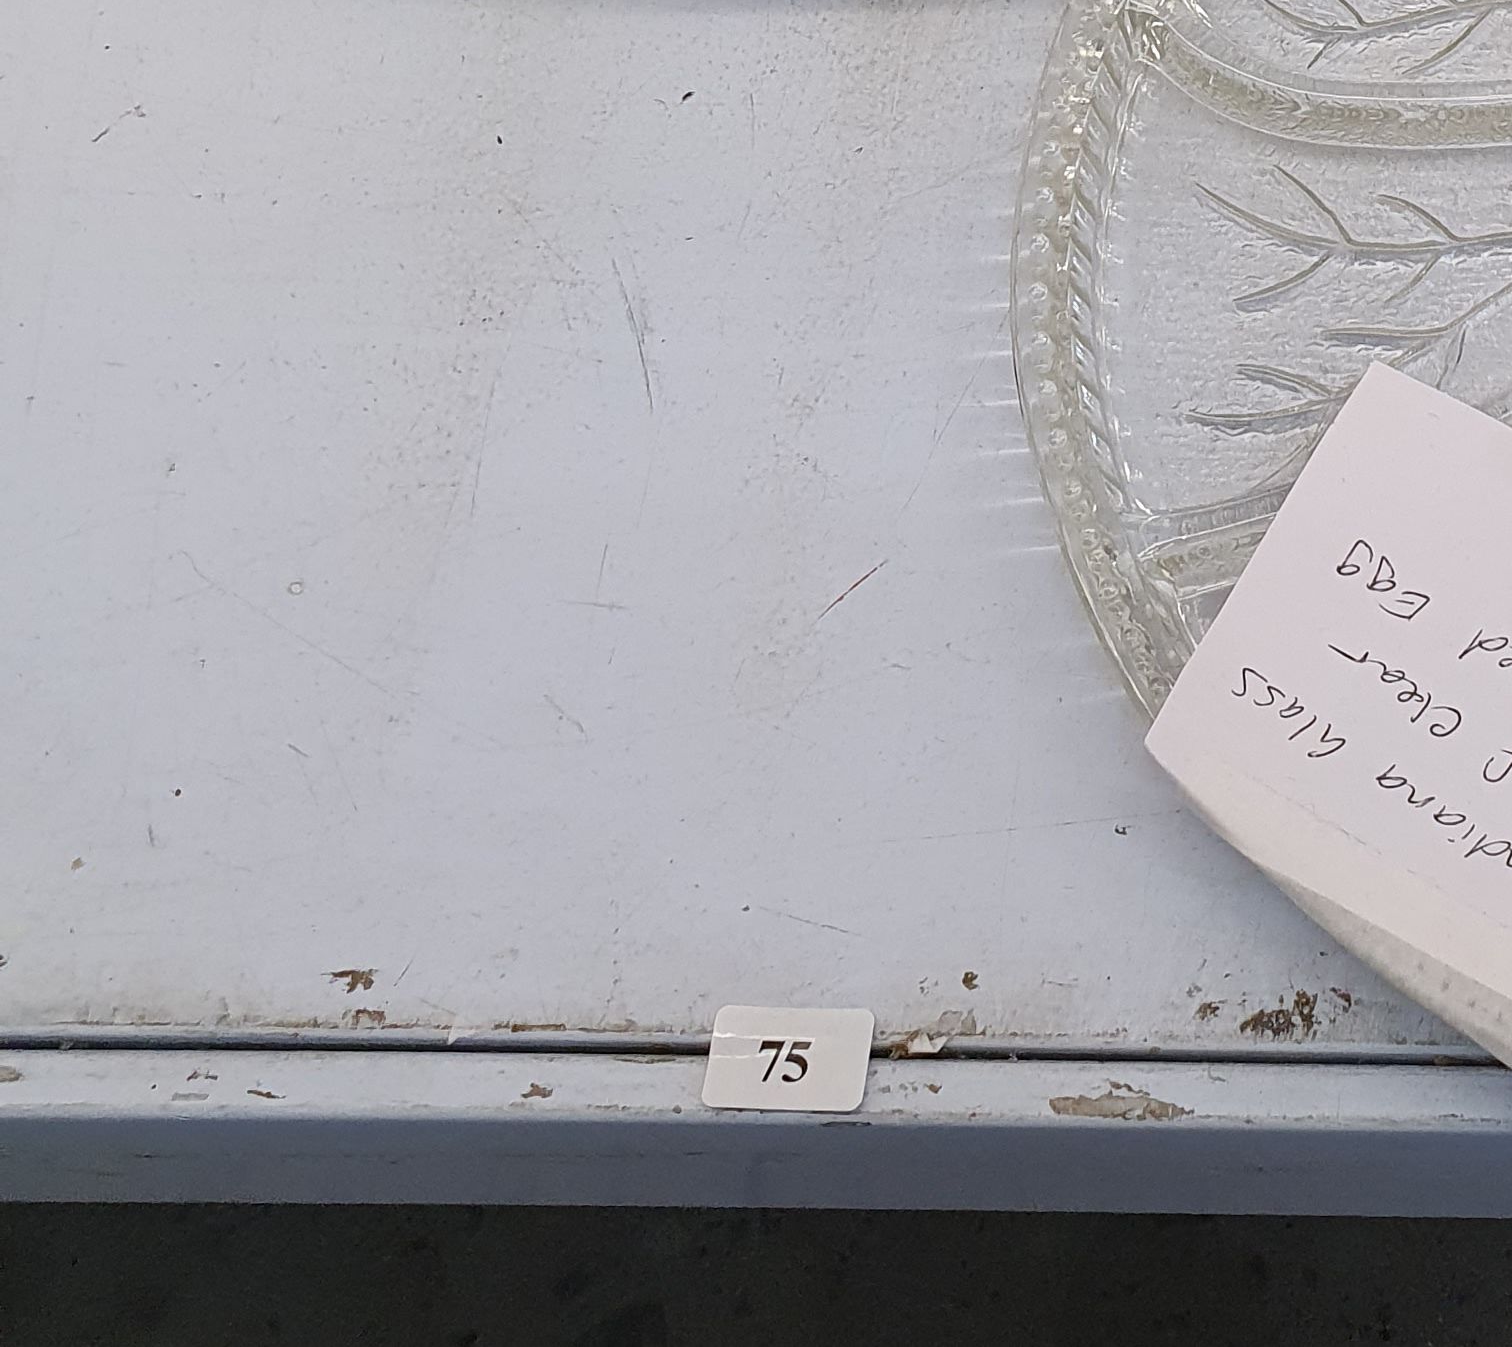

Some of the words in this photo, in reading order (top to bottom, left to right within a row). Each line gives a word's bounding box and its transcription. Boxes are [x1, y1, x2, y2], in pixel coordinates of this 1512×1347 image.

[1336, 539, 1431, 622] Egg
[1231, 667, 1347, 759] Glass
[758, 1040, 813, 1083] 75
